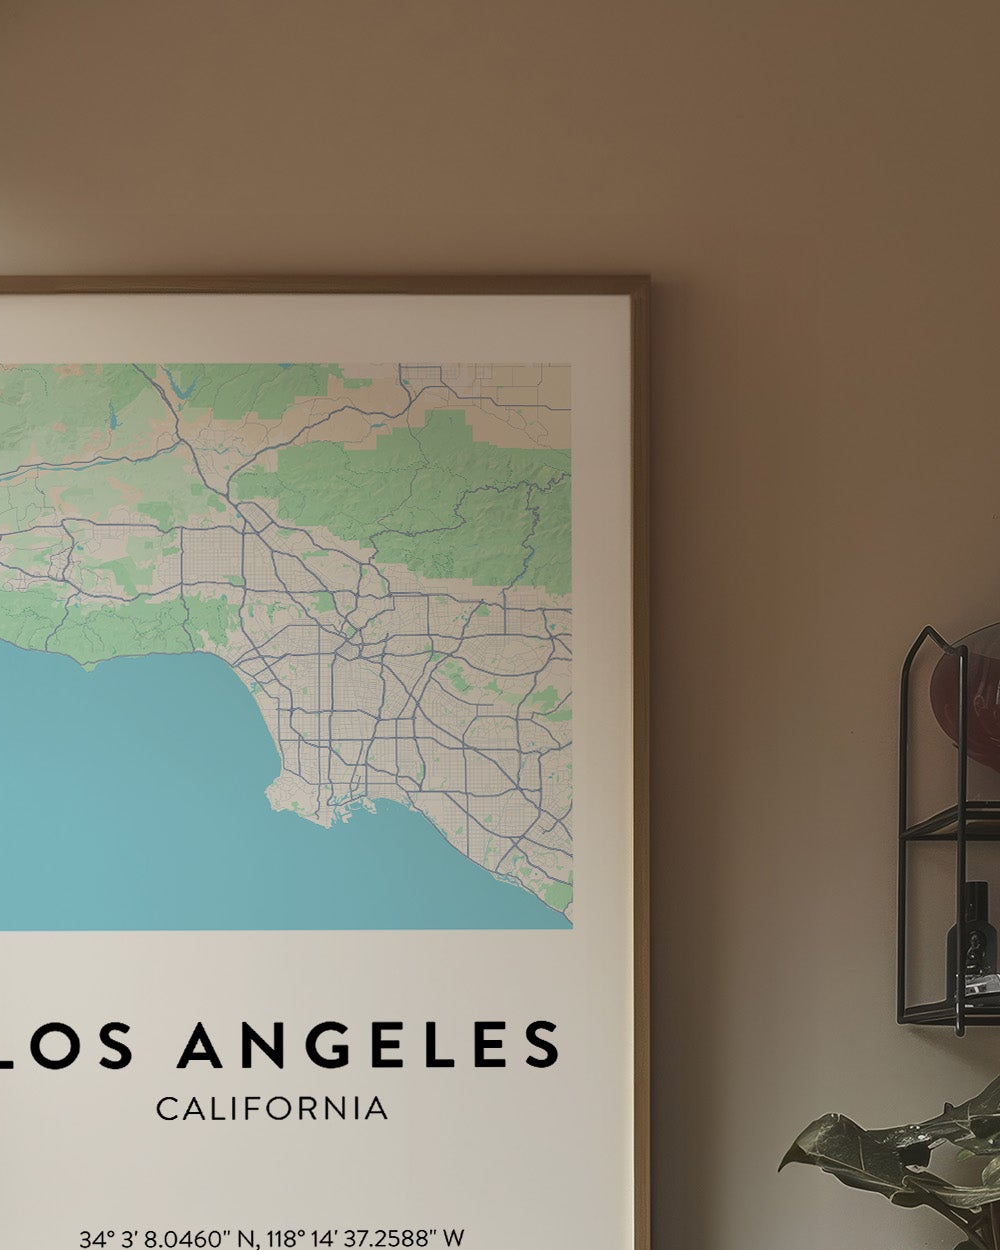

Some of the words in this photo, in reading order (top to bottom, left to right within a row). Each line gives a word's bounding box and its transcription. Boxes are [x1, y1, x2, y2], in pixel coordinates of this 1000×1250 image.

[175, 1020, 559, 1070] ANGELES
[156, 1095, 388, 1121] CALIFORNIA
[79, 1230, 115, 1249] 34°
[267, 1229, 306, 1248] 118°
[442, 1228, 465, 1248] W
